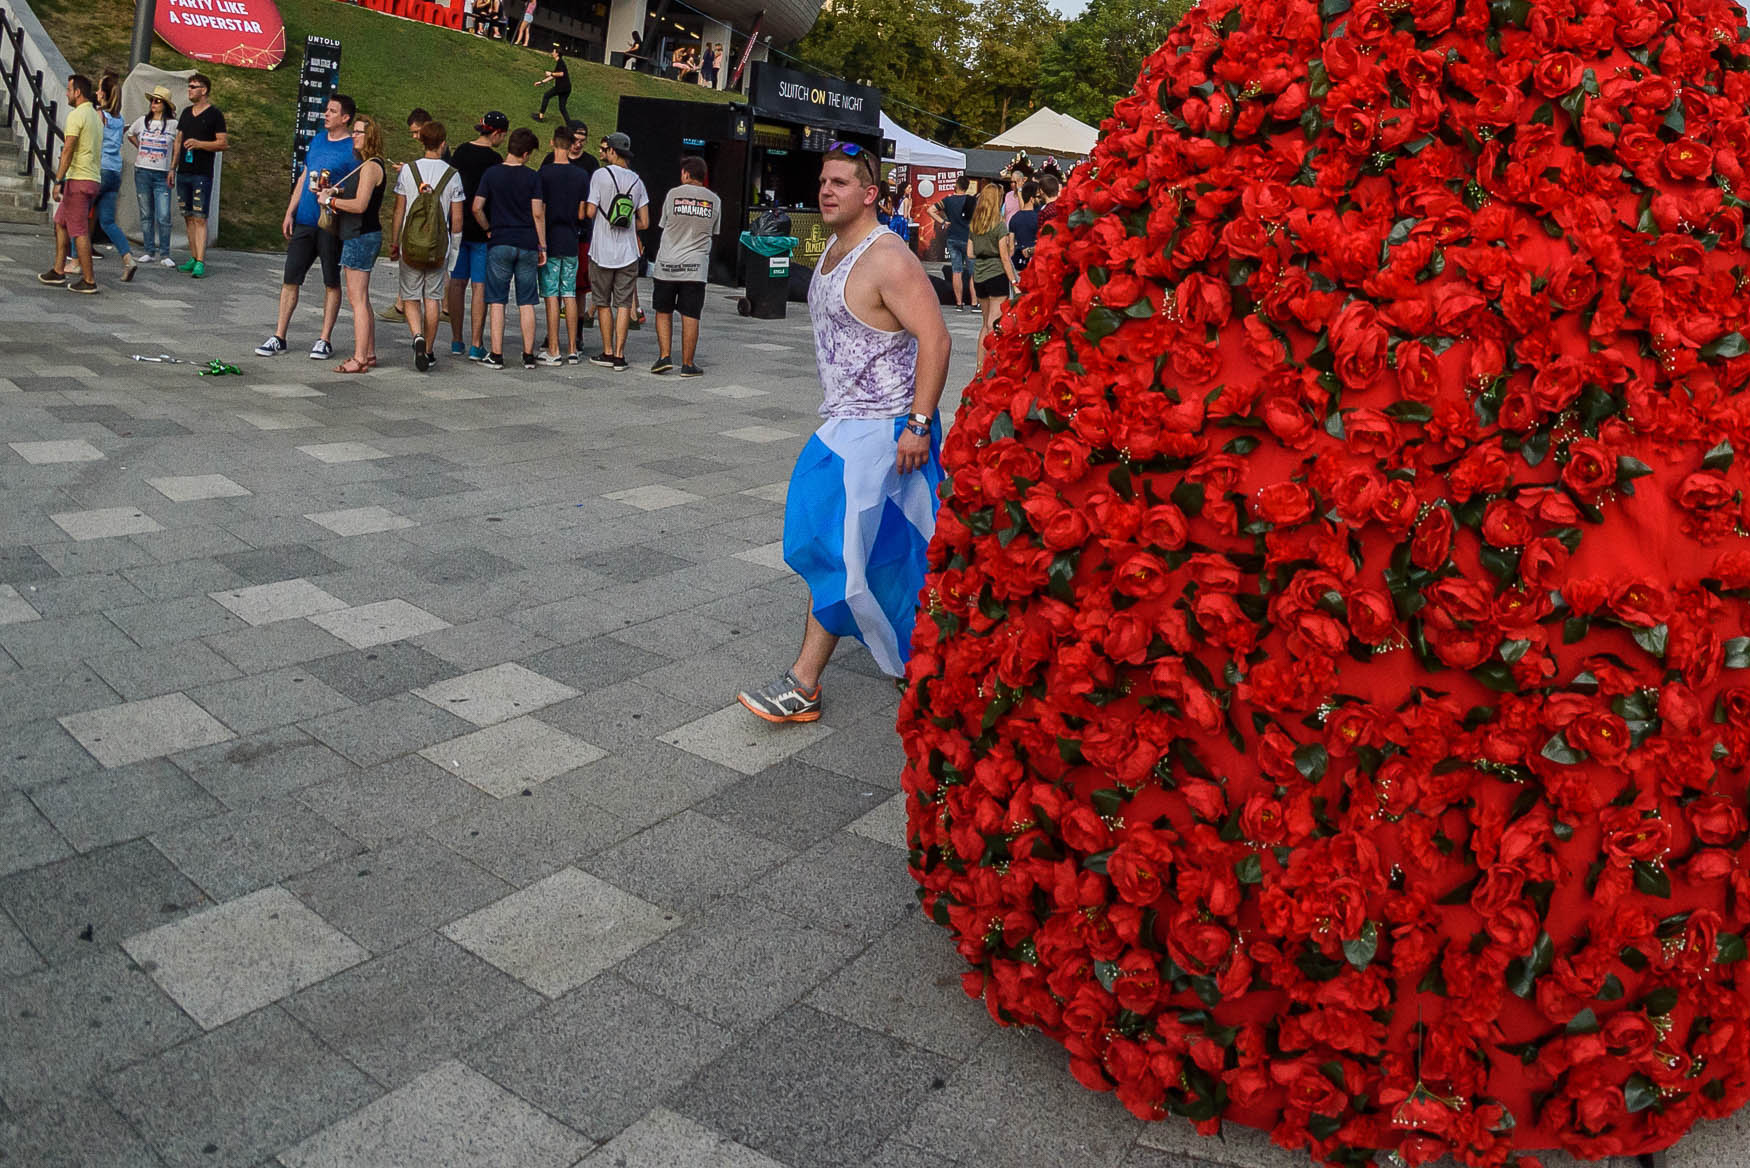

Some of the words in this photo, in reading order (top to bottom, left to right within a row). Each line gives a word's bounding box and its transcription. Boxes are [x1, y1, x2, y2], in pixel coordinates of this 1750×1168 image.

[216, 0, 249, 15] LIKE
[169, 11, 180, 24] A
[181, 13, 263, 34] SUPERSTAR
[308, 35, 340, 46] UNTOLD
[778, 81, 809, 102] SWITCH
[810, 88, 826, 105] ON
[827, 91, 841, 107] THE
[841, 95, 864, 112] NIGHT
[805, 241, 826, 253] OLMECA
